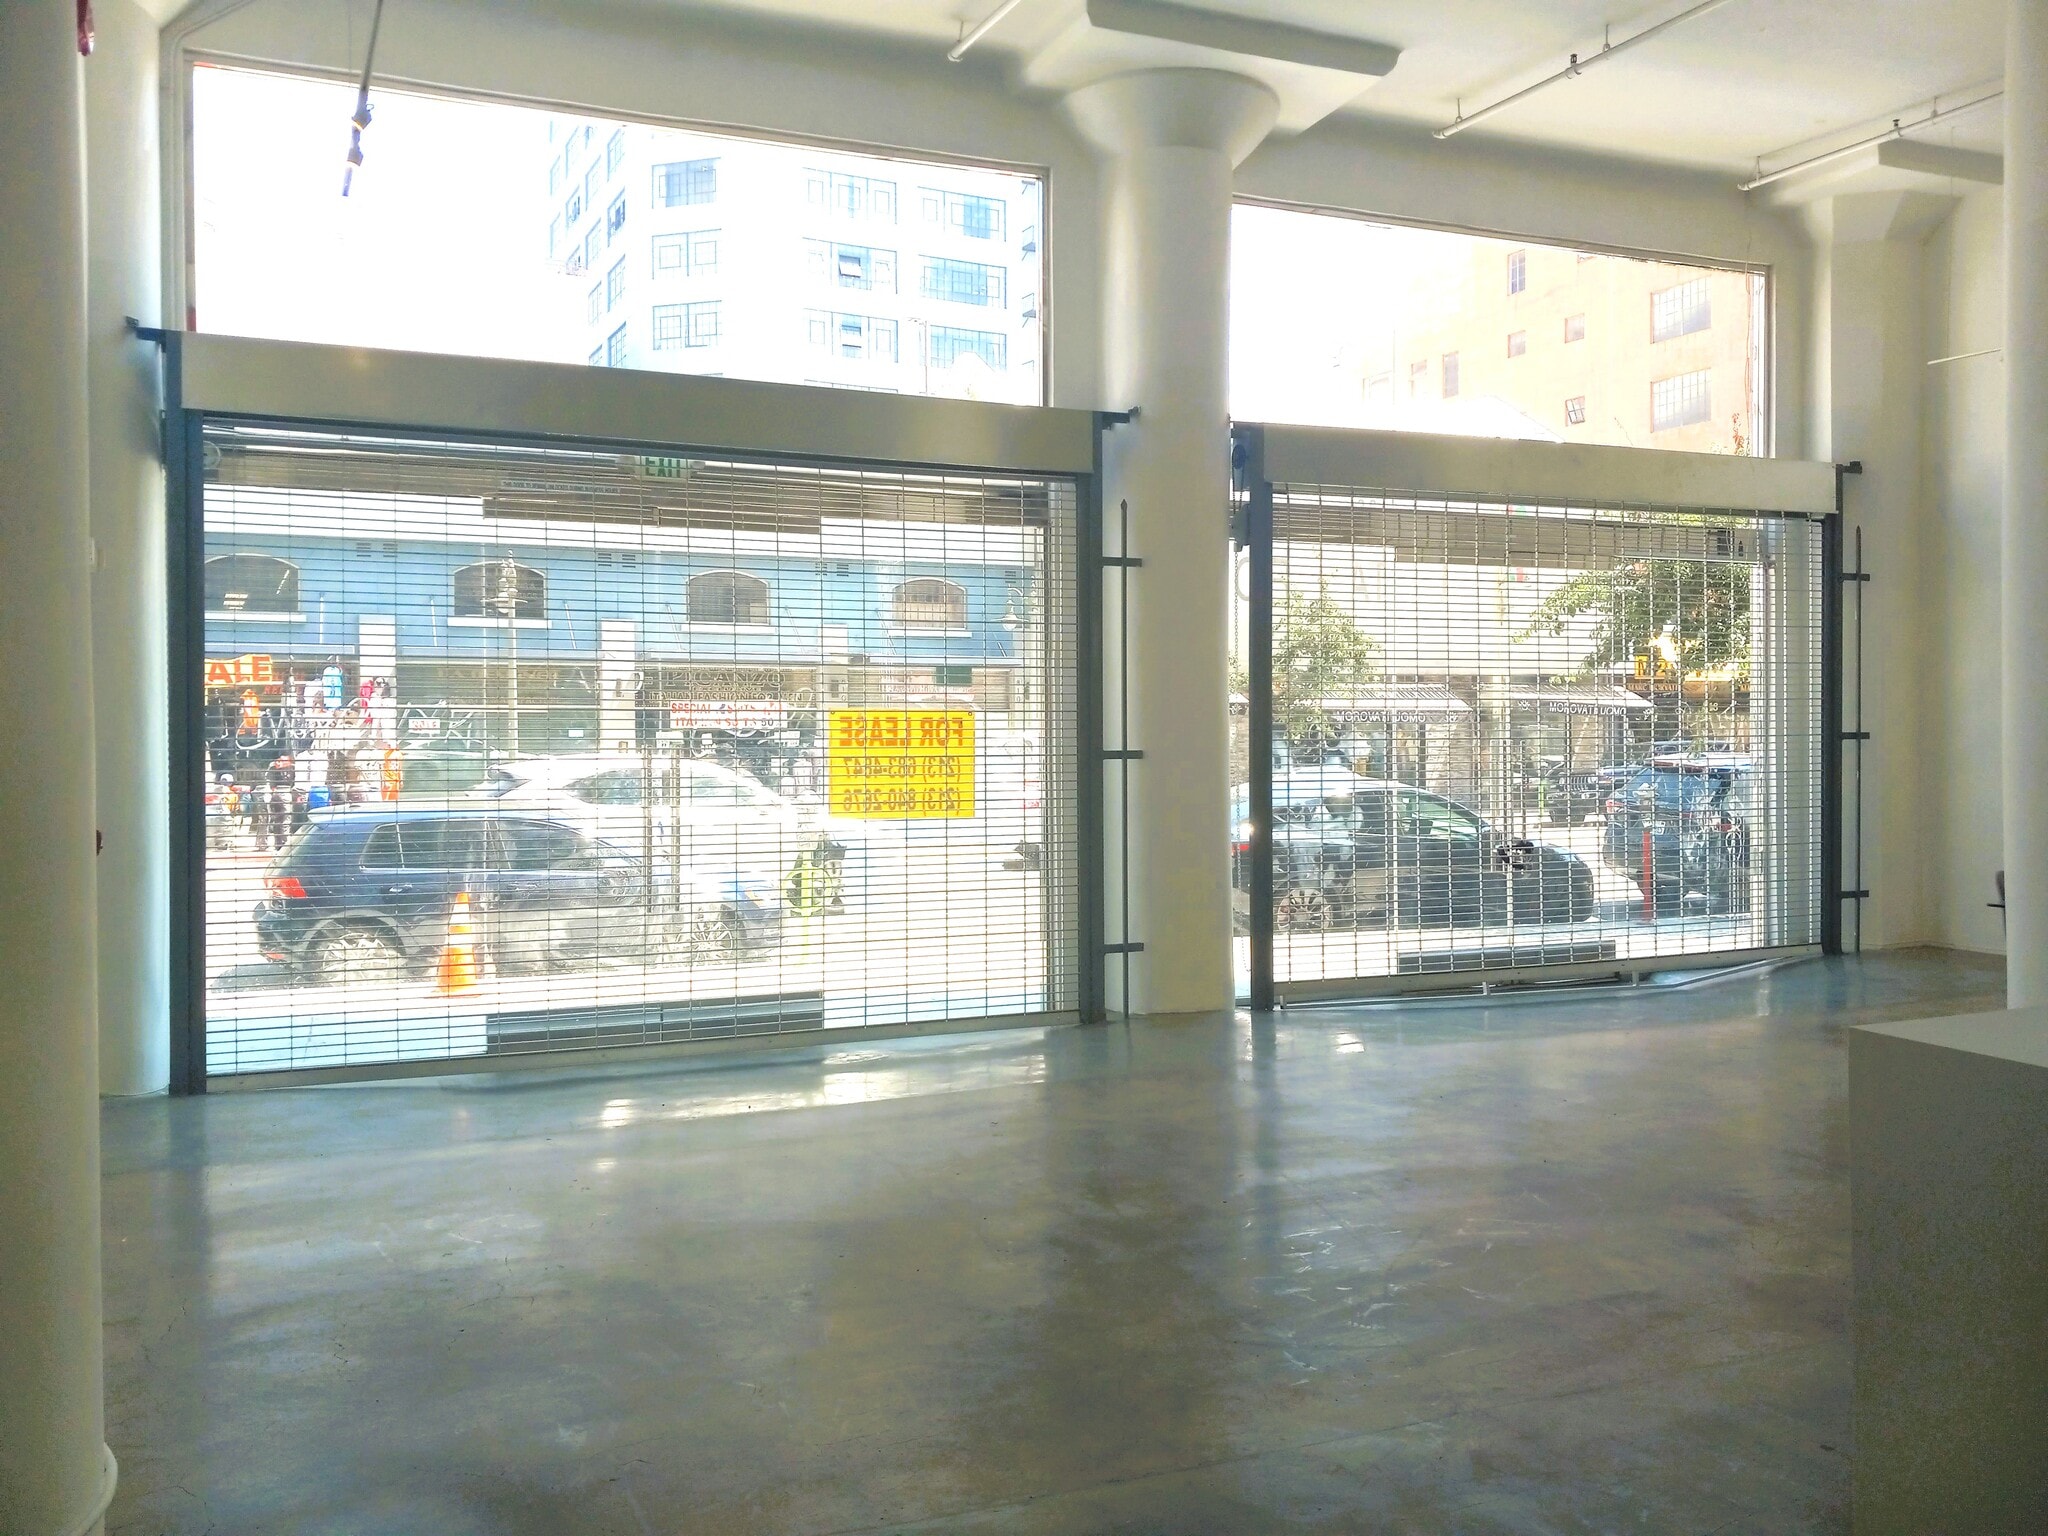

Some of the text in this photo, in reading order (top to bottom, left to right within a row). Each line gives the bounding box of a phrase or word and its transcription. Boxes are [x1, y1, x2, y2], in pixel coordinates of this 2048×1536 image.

[645, 457, 681, 478] EXIT
[204, 656, 270, 684] ALE
[666, 671, 786, 687] PICANZO
[650, 692, 695, 701] ITALIAN
[697, 692, 750, 701] FASHION
[1335, 711, 1390, 722] MOROVATI
[1550, 702, 1627, 717] MOROVATI UOMO
